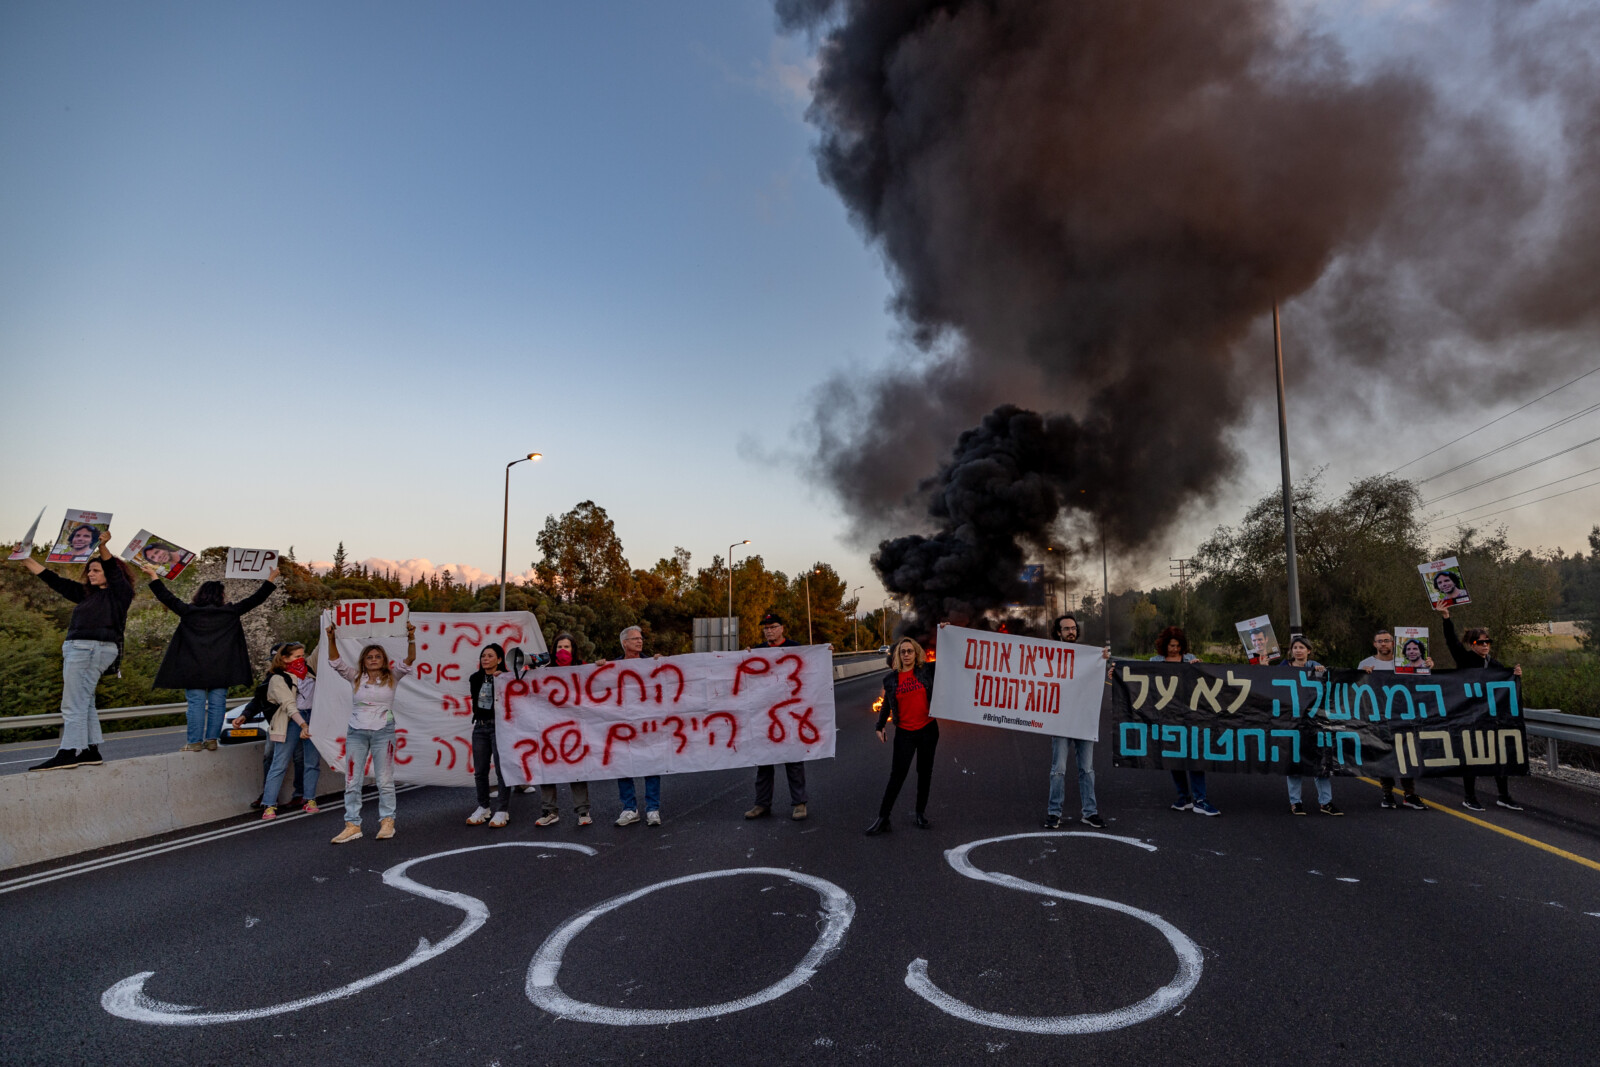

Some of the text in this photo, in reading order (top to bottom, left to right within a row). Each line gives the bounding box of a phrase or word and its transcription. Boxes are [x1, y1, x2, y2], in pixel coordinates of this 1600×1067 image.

[233, 550, 276, 572] HELP
[336, 601, 404, 626] HELP
[731, 653, 803, 696] דם
[964, 638, 1075, 679] תוציאו אותם
[504, 663, 685, 721] החטופים
[973, 672, 1060, 714] מהגיהנום!
[1122, 666, 1519, 721] חיי הממשלה לא על
[513, 697, 820, 782] על הידיים שלך
[982, 712, 1044, 729] #BringThemHomeNow
[1119, 721, 1525, 775] חשבון חיי החטופים
[101, 830, 1205, 1036] SOS
